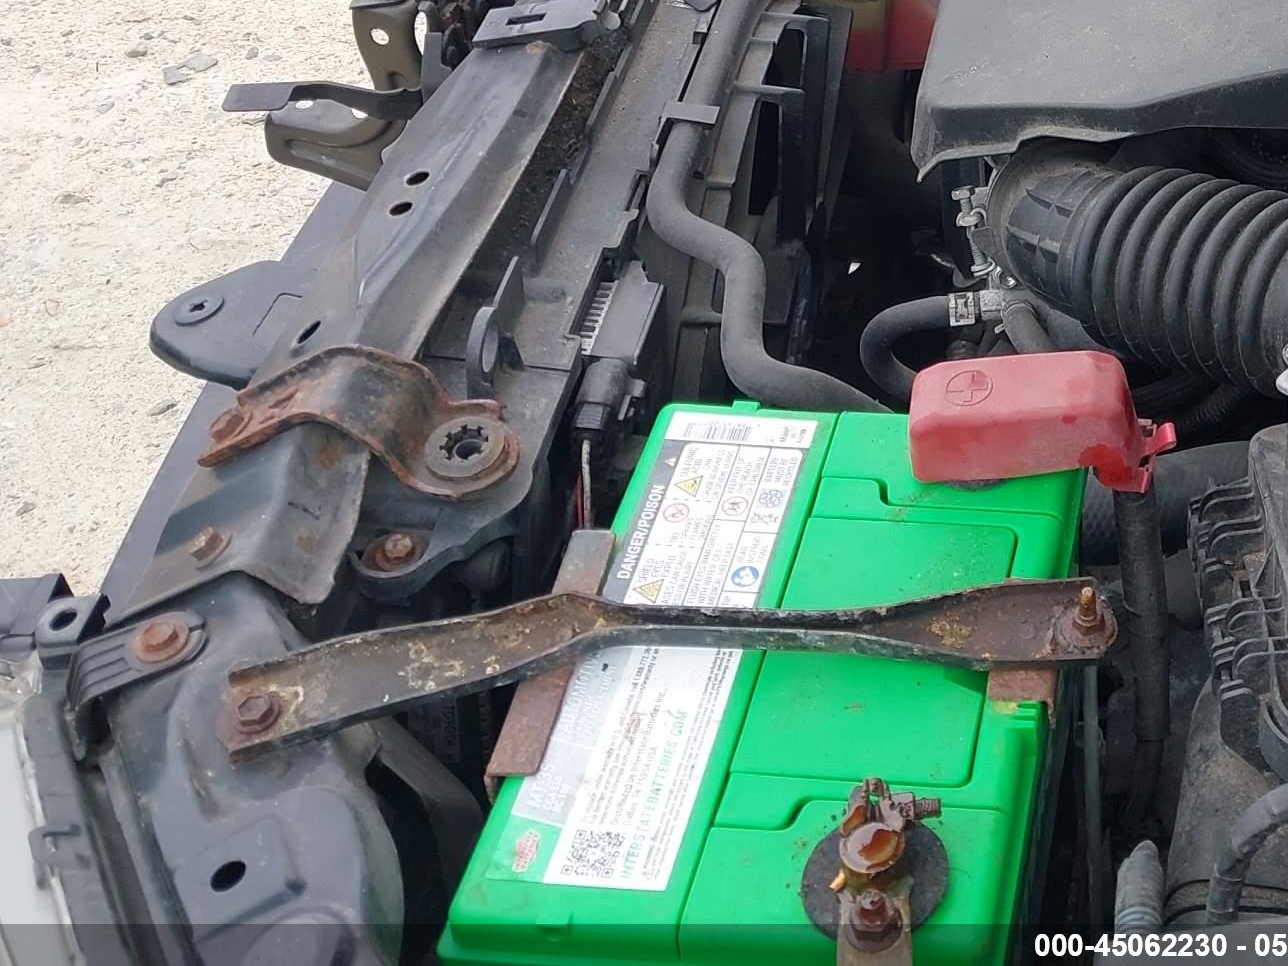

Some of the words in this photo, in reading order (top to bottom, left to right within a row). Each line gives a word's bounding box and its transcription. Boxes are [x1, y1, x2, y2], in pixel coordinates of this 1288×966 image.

[616, 484, 665, 578] DANGER/POISON
[662, 585, 675, 603] ASES
[542, 790, 558, 810] CCA
[618, 709, 689, 879] INTERSTATEBATTERIES.COM
